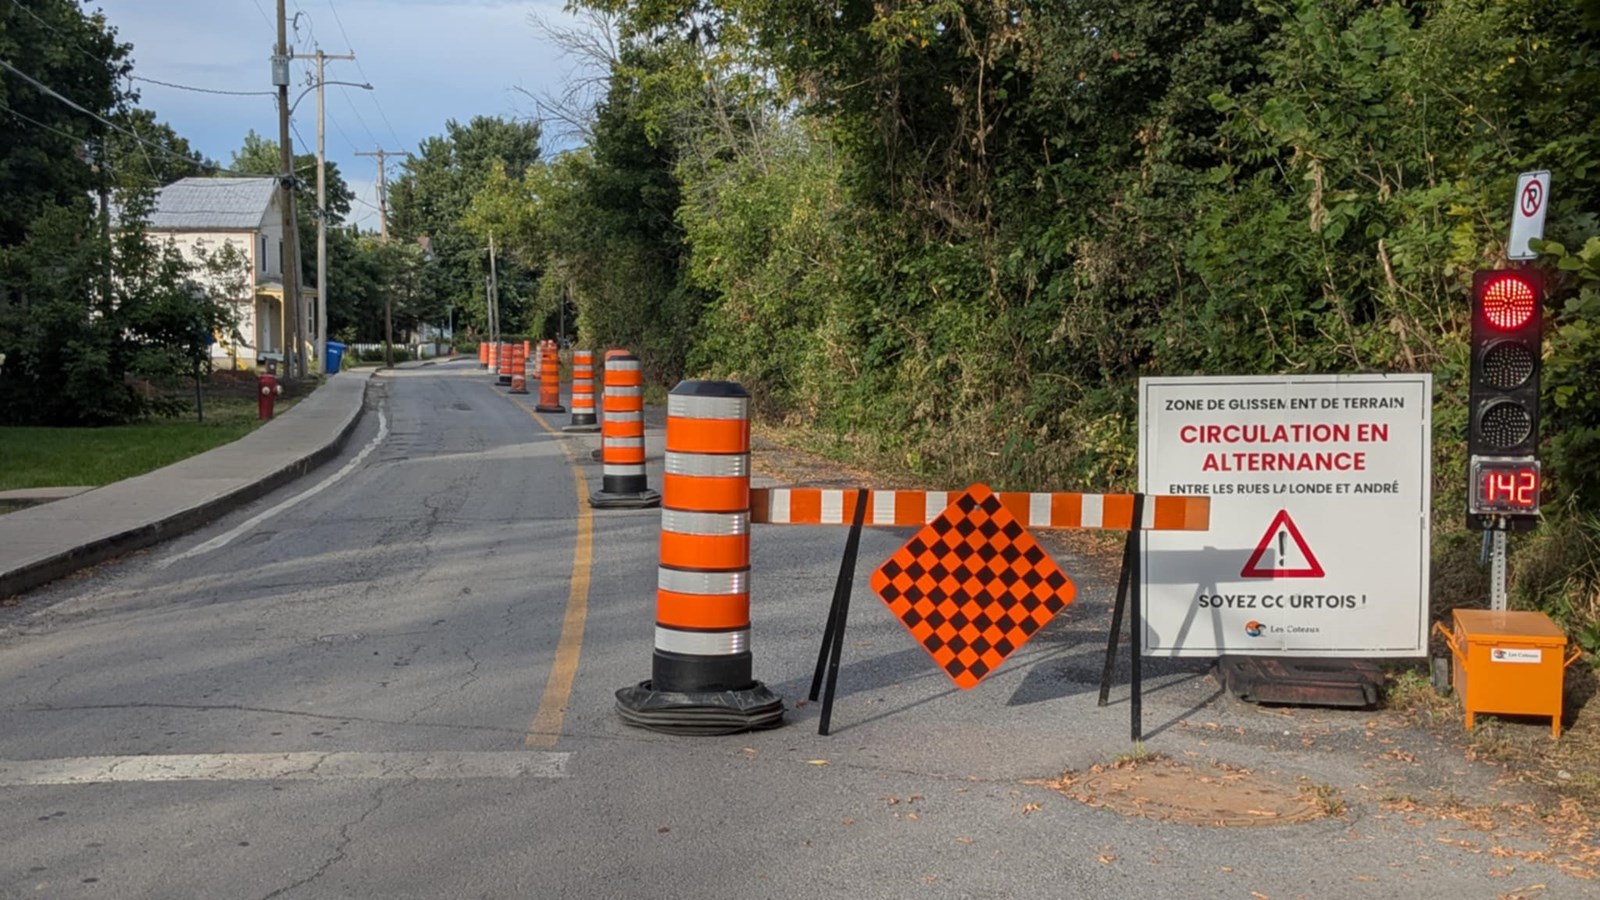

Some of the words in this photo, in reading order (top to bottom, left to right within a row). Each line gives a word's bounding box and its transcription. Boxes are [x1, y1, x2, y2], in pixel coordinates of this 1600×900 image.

[1165, 399, 1203, 411] ZONE
[1207, 399, 1225, 410] DE
[1321, 398, 1339, 409] DE
[1342, 397, 1404, 409] TERRAIN
[1180, 424, 1350, 443] CIRCULATION
[1357, 424, 1388, 442] EN
[1202, 452, 1366, 471] ALTERNANCE
[1169, 484, 1210, 494] ENTRE
[1212, 484, 1234, 494] LES
[1237, 484, 1270, 494] RUES
[1273, 483, 1333, 494] LALONDE
[1336, 483, 1351, 494] ET
[1353, 480, 1399, 494] ANDRÉ
[1489, 472, 1535, 503] 142
[1199, 595, 1257, 608] SOYEZ
[1270, 625, 1285, 634] Les
